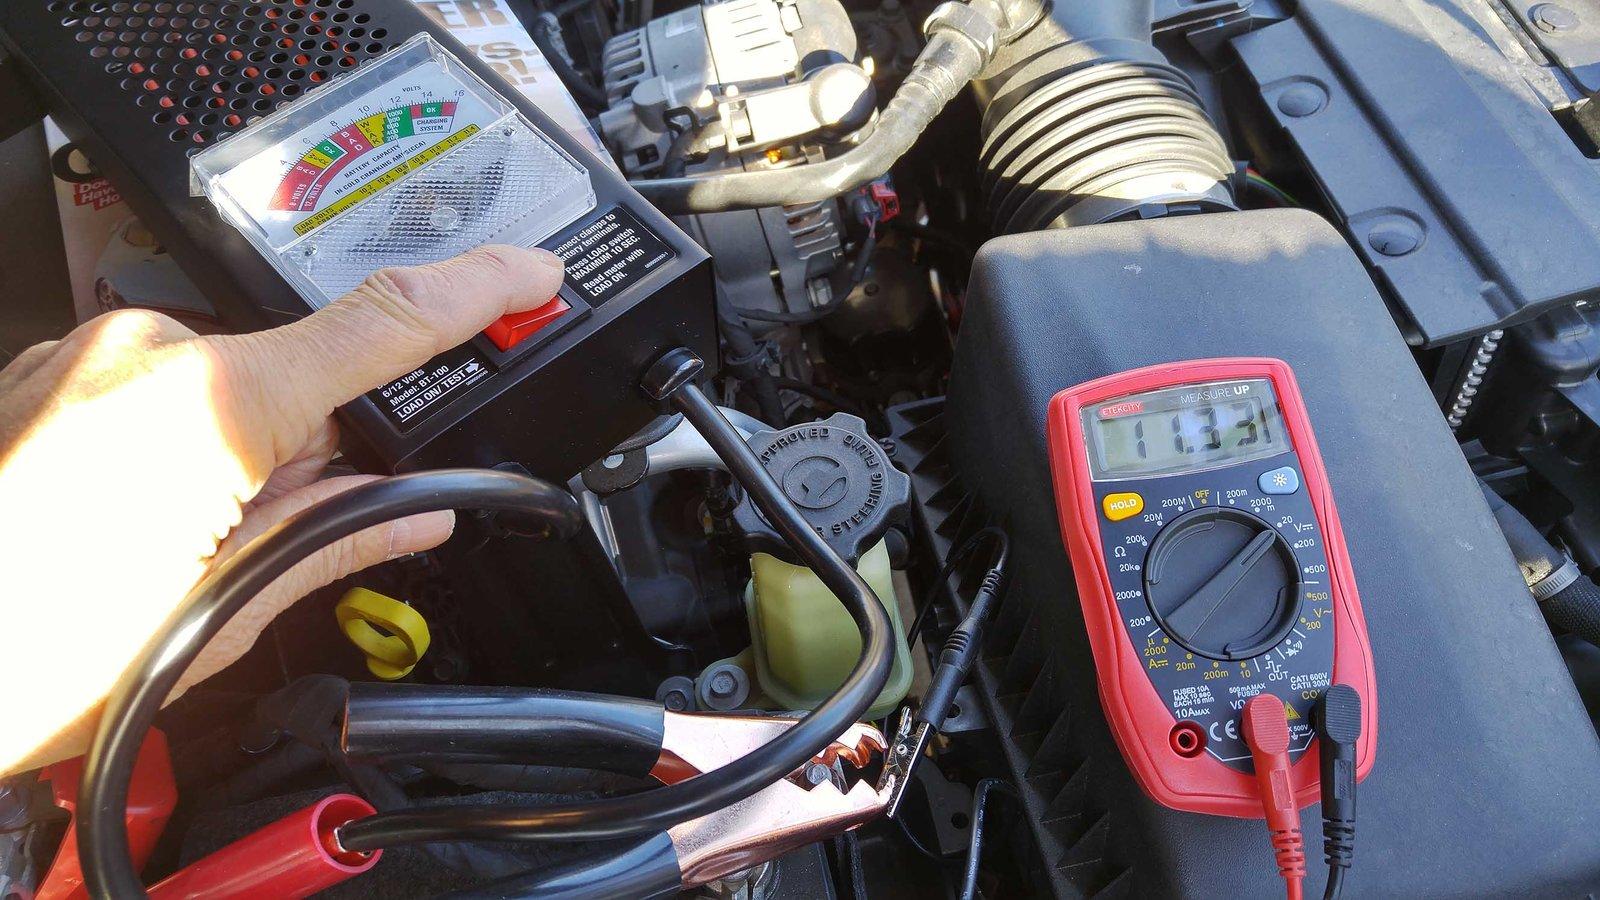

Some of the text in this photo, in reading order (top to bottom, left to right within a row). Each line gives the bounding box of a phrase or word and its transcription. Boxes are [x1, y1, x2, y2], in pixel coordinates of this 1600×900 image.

[402, 85, 422, 93] VOLTS
[303, 137, 311, 145] 6
[358, 105, 371, 115] 10
[390, 95, 402, 105] 12
[422, 91, 433, 99] 14
[454, 89, 465, 98] 16
[417, 118, 449, 126] CHARGING
[360, 120, 380, 145] WEAK
[341, 131, 364, 151] BAD
[344, 144, 401, 179] BATTERY CAPACITY
[297, 165, 316, 176] BAD
[334, 188, 343, 196] IN
[344, 178, 360, 191] COLD
[360, 160, 392, 180] CRANKING
[297, 217, 313, 231] LOAD
[314, 207, 335, 221] VOLTS
[554, 214, 616, 255] onnect clamps to
[561, 245, 584, 262] attery
[565, 228, 635, 275] Press LOAD switch
[572, 235, 641, 281] MAXIMUM 10 SEC.
[582, 274, 605, 291] Read
[603, 260, 627, 278] meter
[626, 248, 645, 263] with
[590, 270, 628, 297] LOAD ON.
[382, 383, 405, 399] 6/12
[402, 368, 426, 386] Volts
[389, 386, 421, 407] Model:
[418, 365, 450, 388] BT-100
[397, 399, 425, 420] LOAD
[423, 385, 443, 402] ON/
[441, 370, 467, 390] TEST
[1180, 385, 1251, 405] MEASURE UP
[1102, 403, 1142, 417] ETEKCITY
[1195, 490, 1211, 499] OFF
[1226, 488, 1248, 499] 200m
[1109, 498, 1138, 512] HOLD
[1162, 497, 1187, 508] 200M
[1251, 497, 1272, 508] 2000
[1144, 512, 1164, 523] 20M
[1281, 515, 1294, 525] 20
[1126, 534, 1146, 545] 200k
[1299, 538, 1316, 548] 200
[1115, 546, 1127, 558] Ω
[1120, 564, 1135, 573] 20k
[1309, 564, 1326, 574] 500
[1116, 590, 1137, 600] 2000
[1312, 592, 1329, 602] 500
[1130, 617, 1146, 628] 200
[1306, 620, 1322, 631] 200
[1144, 646, 1167, 657] 2000
[1176, 662, 1197, 672] 20m
[1204, 669, 1229, 680] 200m
[1240, 670, 1251, 680] 10
[1268, 671, 1289, 682] OUT
[1310, 672, 1328, 681] 600V
[1312, 679, 1331, 688] 300V
[1173, 685, 1210, 696] FUSED 10A
[1238, 690, 1261, 698] FUSED
[1302, 689, 1321, 700] CO
[1174, 694, 1190, 702] MAX
[1174, 700, 1193, 708] EACH
